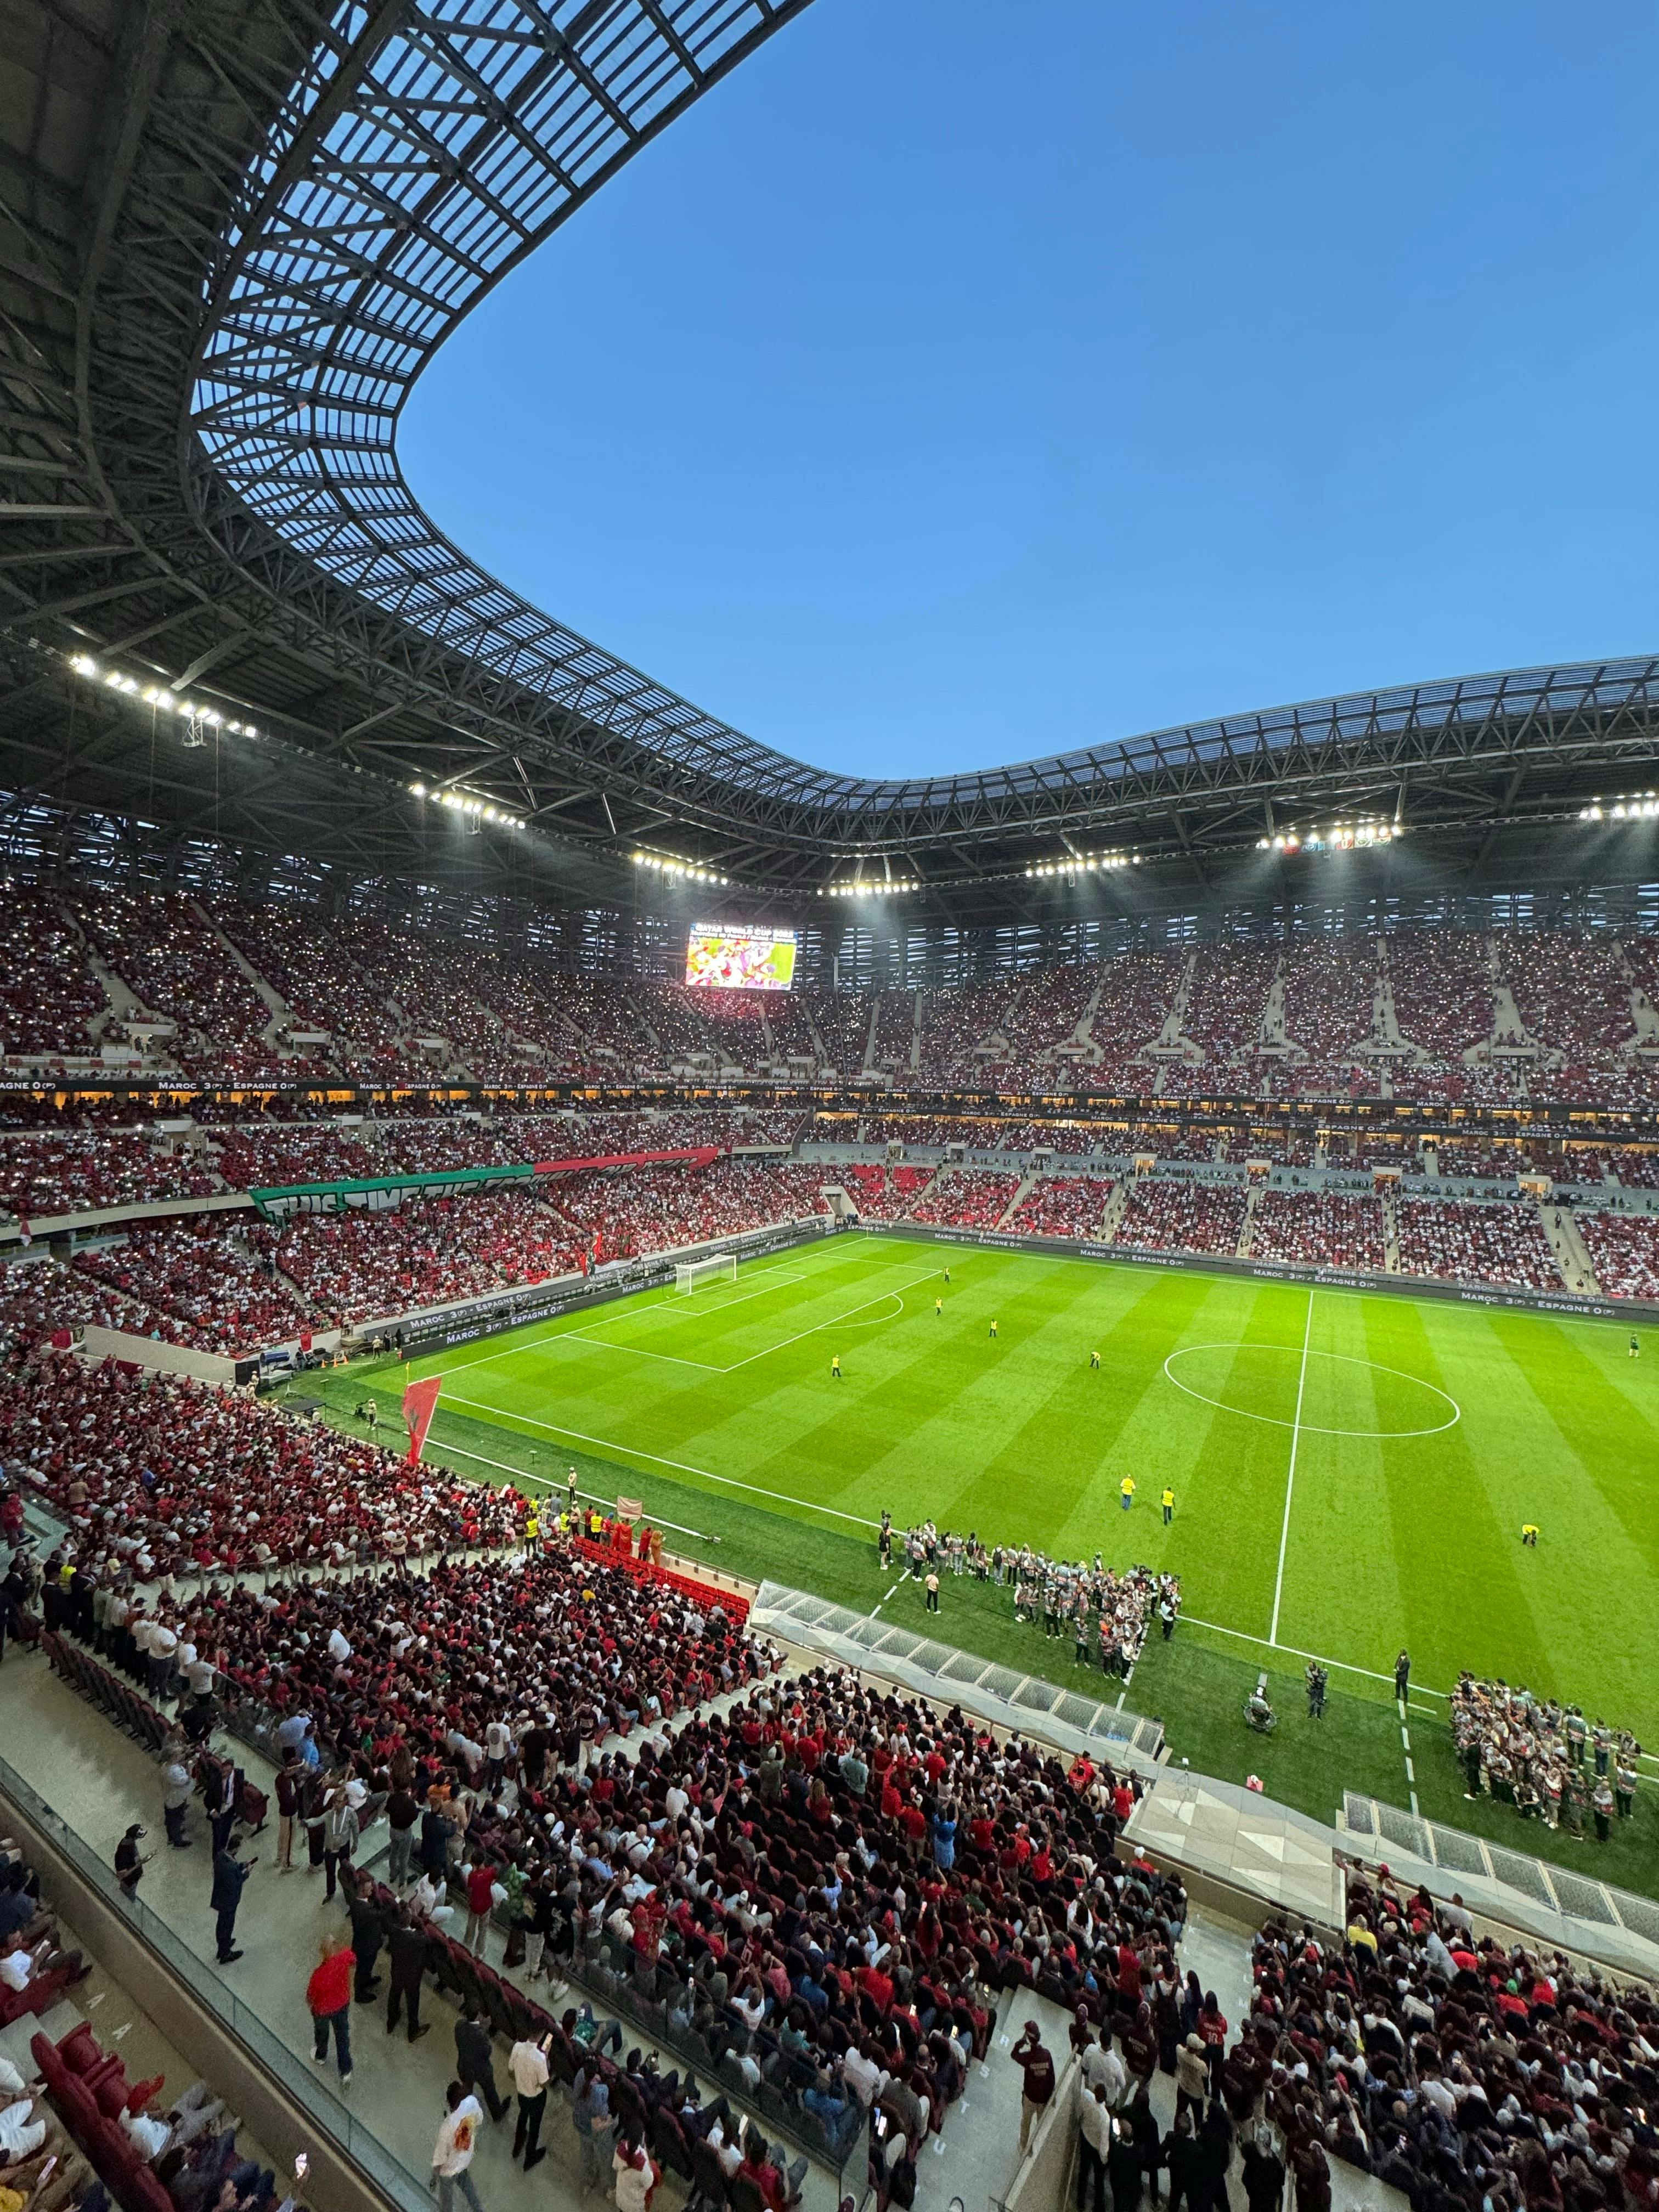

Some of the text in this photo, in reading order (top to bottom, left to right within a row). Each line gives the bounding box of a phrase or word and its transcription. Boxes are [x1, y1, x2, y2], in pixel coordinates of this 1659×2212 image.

[695, 924, 723, 933] QATAR
[724, 926, 753, 935] WORLD
[740, 1251, 756, 1260] MAROC
[770, 1242, 789, 1251] ESPAGNE
[1080, 1249, 1106, 1258] MAROC
[1132, 1255, 1167, 1265] ESPAGNE
[1256, 1261, 1285, 1269] MAROC
[1253, 1269, 1284, 1278] MAROC
[1314, 1276, 1356, 1286] ESPAGNE
[623, 1282, 644, 1293] MAROC
[1458, 1282, 1494, 1292] MAROC
[1533, 1290, 1583, 1301] ESPAGNE
[1461, 1292, 1499, 1304] MAROC
[1537, 1301, 1589, 1313] ESPAGNE
[410, 1315, 445, 1328] MAROC
[476, 1299, 515, 1312] ESPAGNE
[447, 1329, 479, 1344] MAROC
[511, 1310, 548, 1325] ESPAGNE
[86, 1993, 105, 2009] A
[112, 2022, 132, 2040] A
[979, 2065, 990, 2079] S
[961, 2100, 970, 2113] T
[934, 2138, 946, 2155] U
